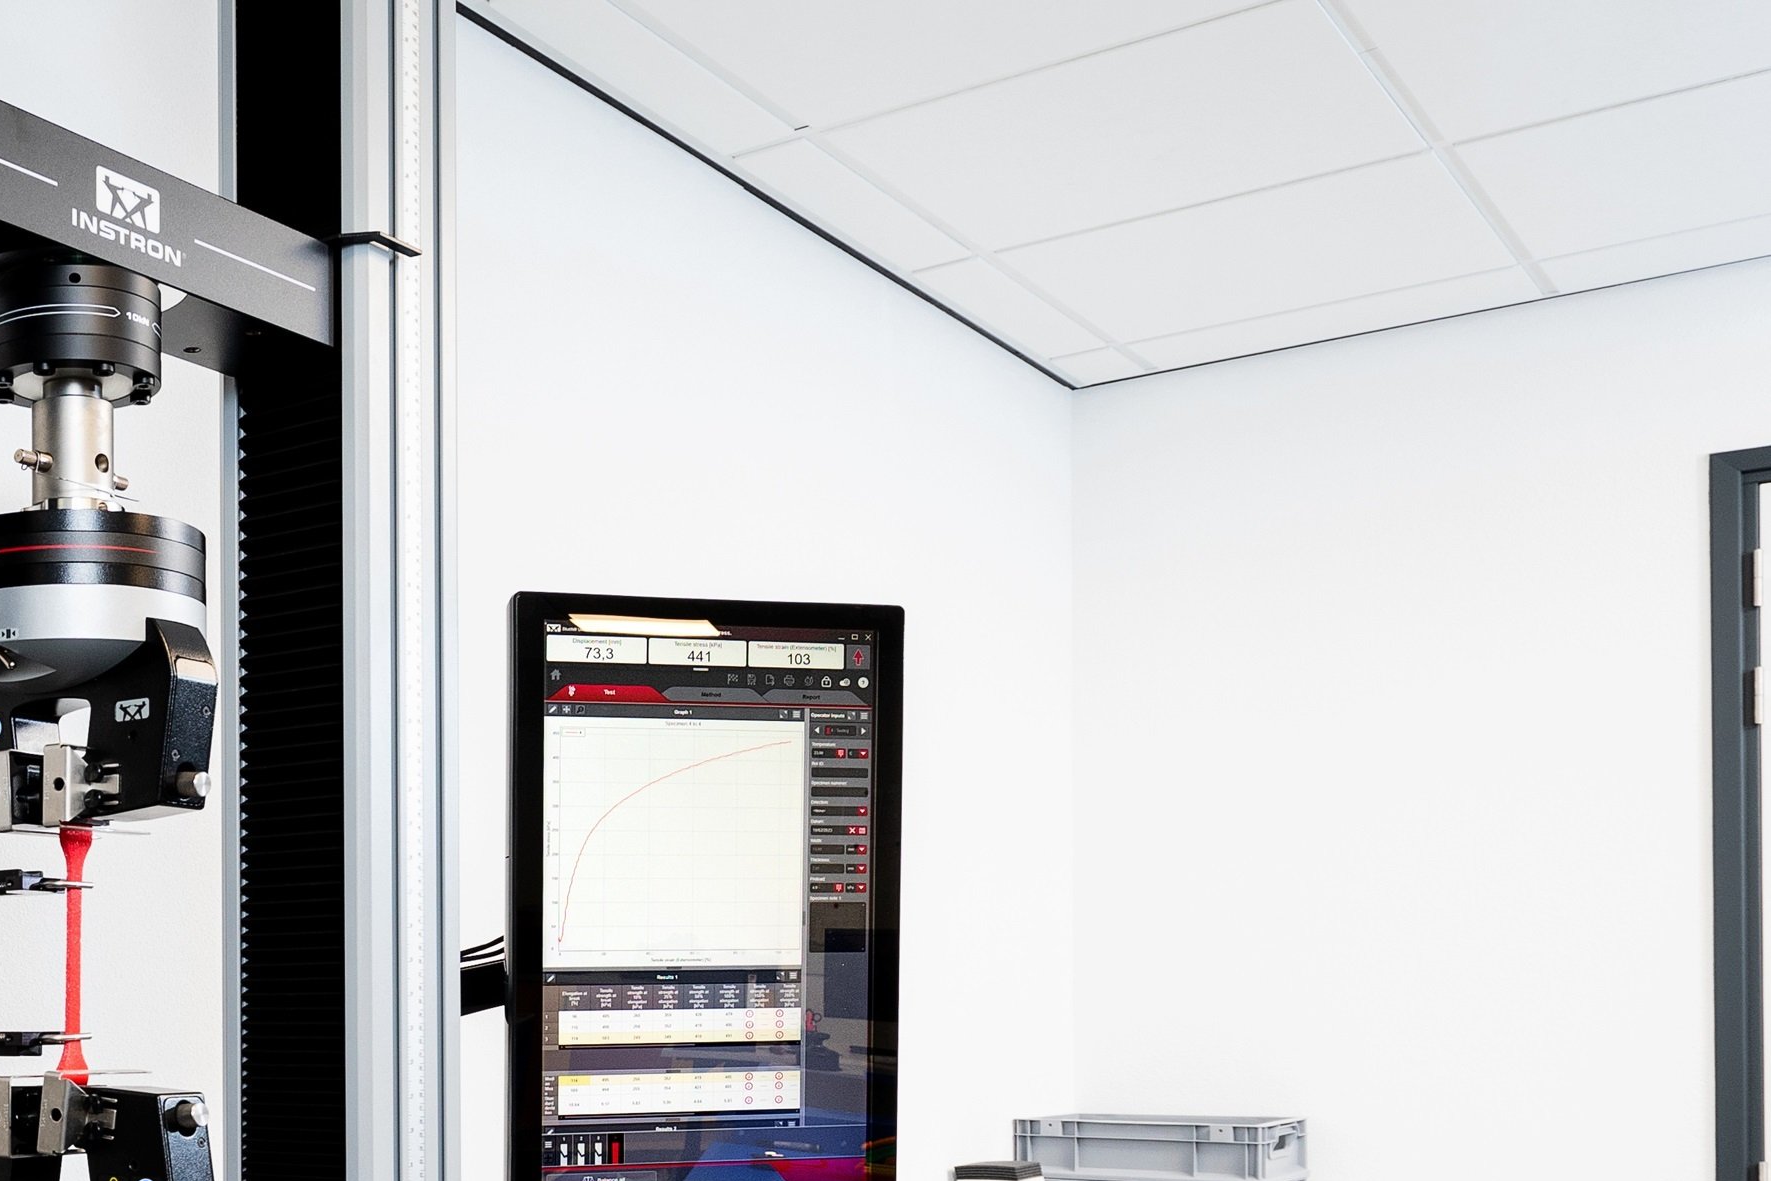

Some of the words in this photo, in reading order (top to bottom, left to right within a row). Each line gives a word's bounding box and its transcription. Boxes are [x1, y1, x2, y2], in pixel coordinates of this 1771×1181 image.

[584, 647, 614, 661] 73,3
[687, 651, 711, 662] 441
[787, 653, 811, 665] 103
